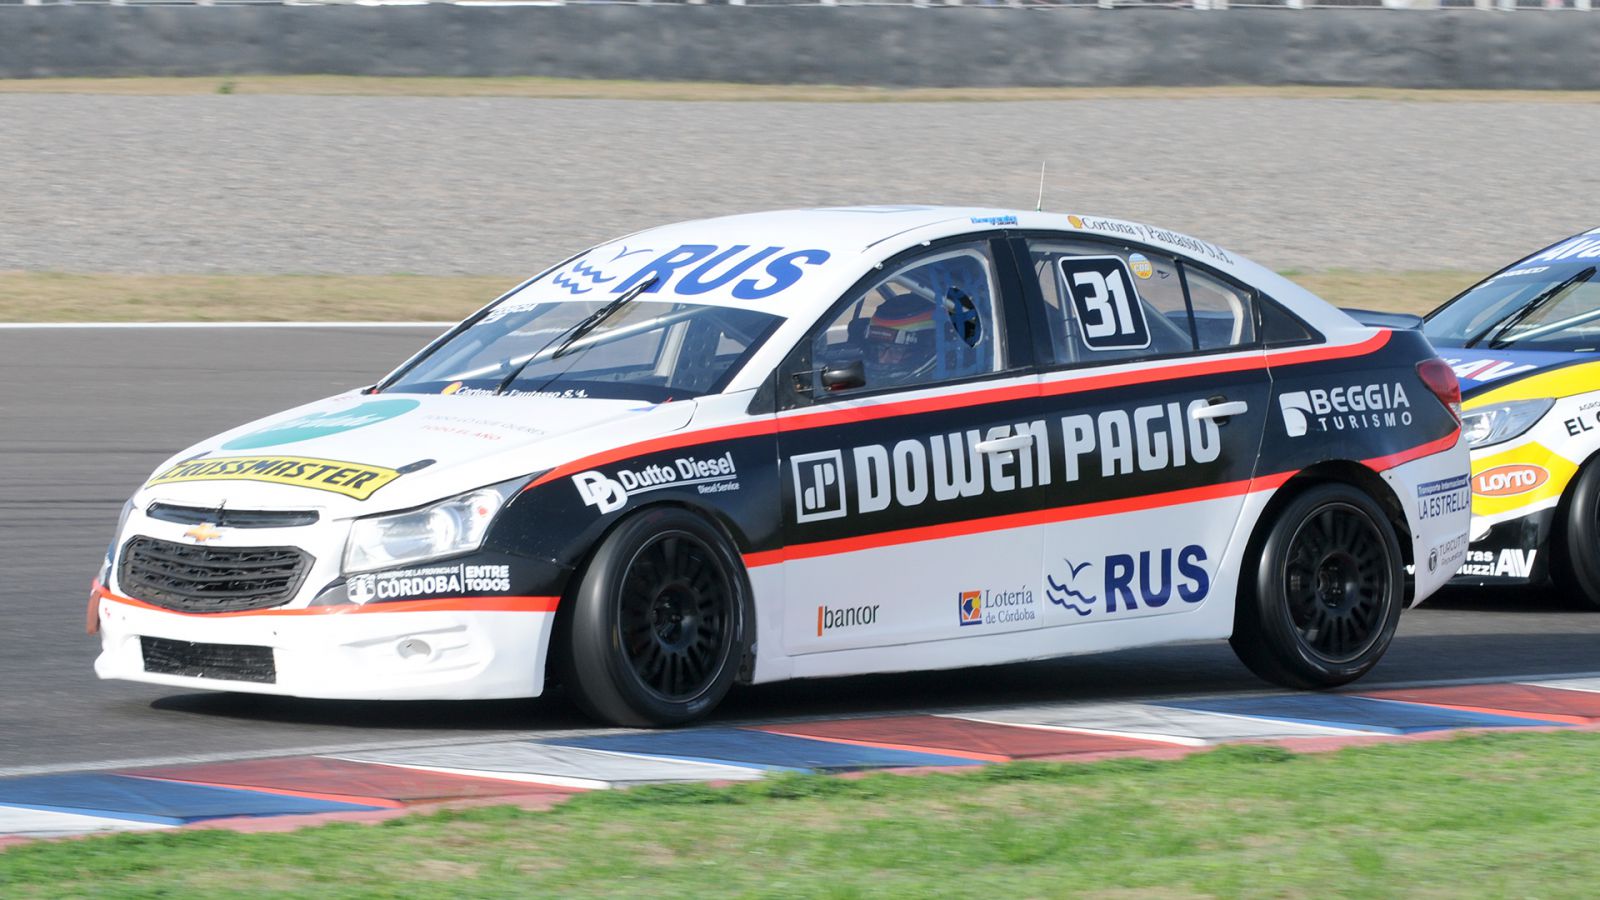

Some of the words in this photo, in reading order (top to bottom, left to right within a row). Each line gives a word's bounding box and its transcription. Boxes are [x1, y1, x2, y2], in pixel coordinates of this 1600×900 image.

[1081, 216, 1133, 234] Cortona
[1133, 225, 1146, 241] y
[1147, 224, 1205, 257] Pautasso
[610, 244, 831, 300] RUS
[1073, 268, 1136, 338] 31
[1309, 382, 1410, 415] BEGGIA
[1318, 411, 1412, 432] TURISMO
[1564, 416, 1594, 437] EL
[1061, 398, 1221, 482] PAGIO
[158, 460, 379, 490] CROSSMASTER
[617, 464, 677, 491] Dutto
[675, 451, 737, 480] Diesel
[1479, 469, 1537, 492] LOYTO
[1418, 497, 1429, 520] LA
[1430, 490, 1469, 518] ESTRELLA
[1466, 550, 1494, 562] ras
[464, 565, 510, 578] ENTRE
[464, 578, 511, 591] TODOS
[1104, 544, 1211, 613] RUS
[377, 574, 461, 599] CÓRDOBA
[985, 584, 1033, 609] Lotería
[823, 603, 880, 629] bancor
[986, 612, 996, 625] de
[998, 608, 1035, 623] Córdoba
